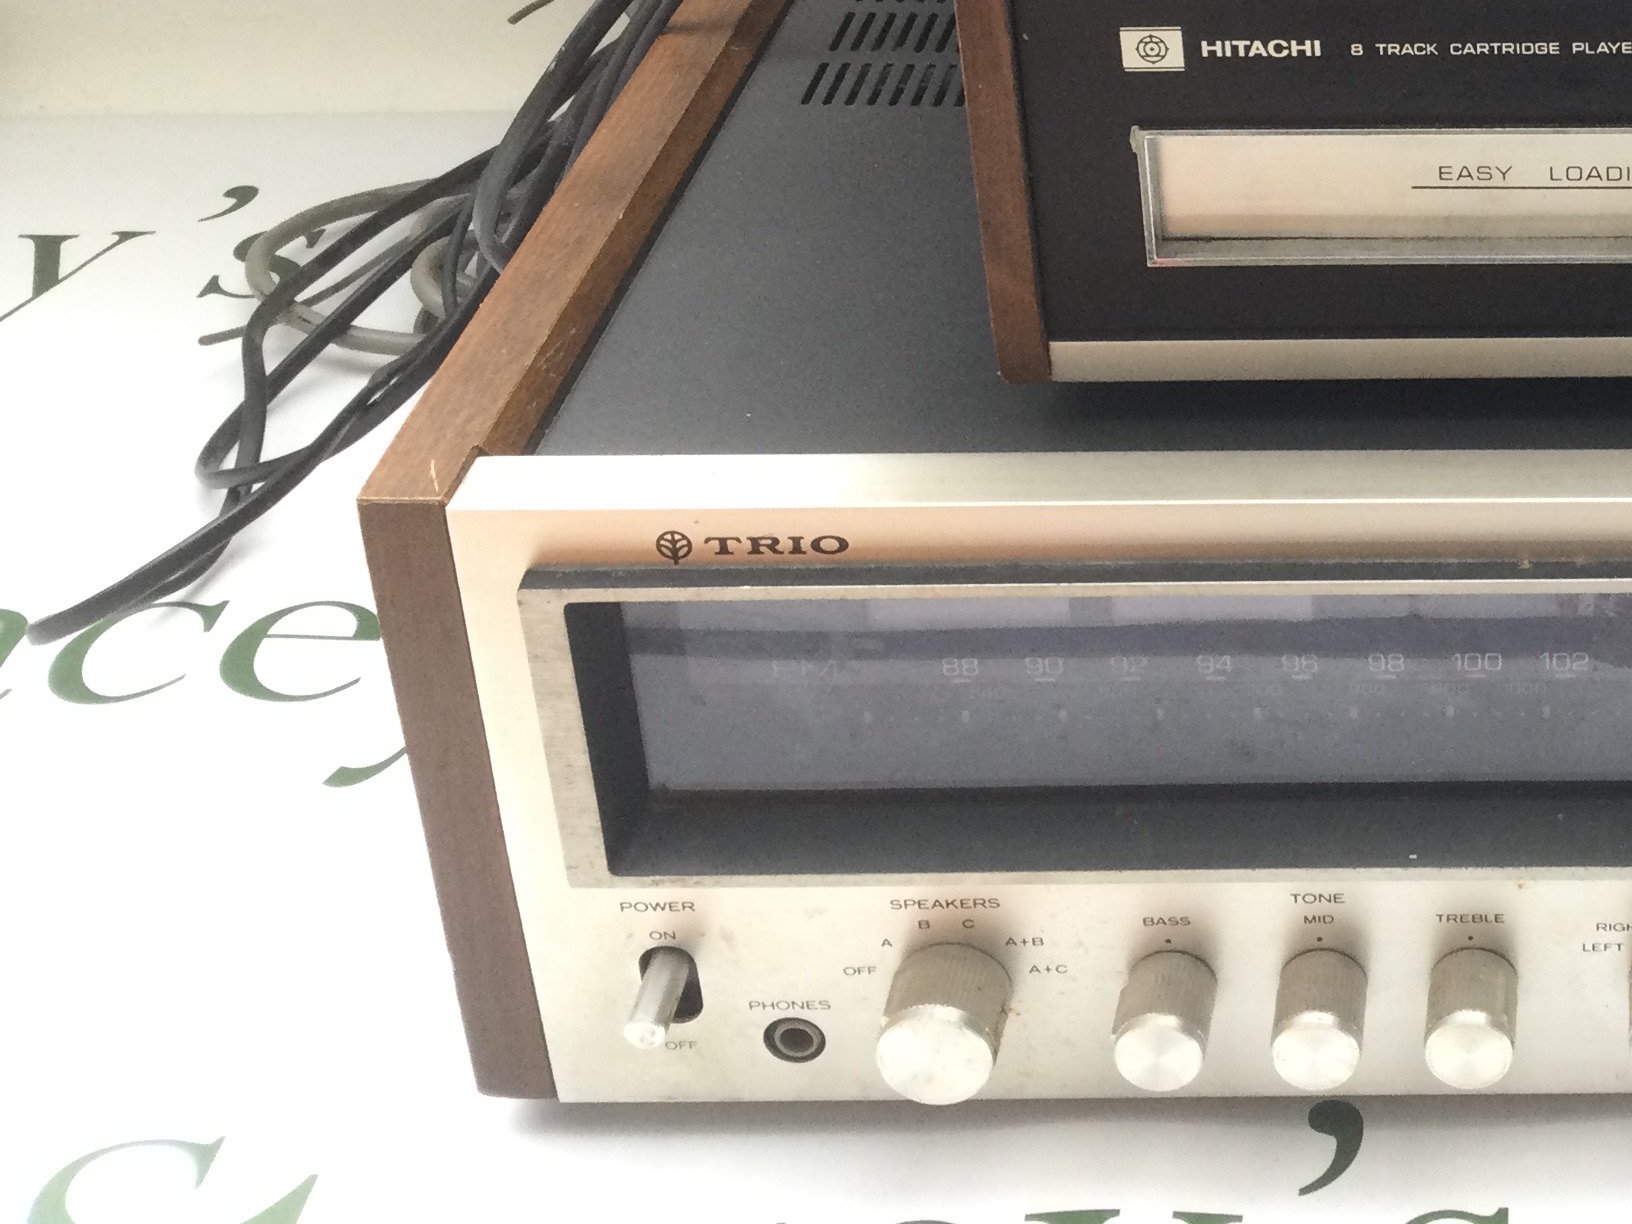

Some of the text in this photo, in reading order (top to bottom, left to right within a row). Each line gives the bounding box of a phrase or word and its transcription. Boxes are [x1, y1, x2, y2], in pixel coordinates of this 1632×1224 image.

[1201, 40, 1321, 57] HITACHI
[1351, 44, 1363, 55] 8
[1375, 43, 1438, 55] TRACK
[1450, 43, 1559, 55] CARTRIDGE
[1439, 166, 1512, 181] EASY
[704, 535, 849, 555] TRIO
[942, 658, 979, 676] 88
[1025, 656, 1064, 675] 90
[1197, 656, 1232, 673] 94
[1368, 653, 1405, 672] 98
[1451, 653, 1502, 672] 100
[1539, 652, 1589, 671] 102
[890, 898, 1000, 910] SPEAKERS
[1291, 894, 1344, 904] TONE
[620, 902, 695, 912] POWER
[1143, 917, 1190, 926] BASS
[1304, 915, 1334, 924] MID
[1436, 914, 1504, 923] TREBLE
[918, 919, 974, 929] B C
[649, 931, 676, 939] ON
[882, 937, 1044, 947] A A+B
[1583, 943, 1621, 952] LEFT
[843, 965, 1067, 975] OFF A+C
[749, 1000, 831, 1010] PHONES
[664, 1040, 699, 1050] OFF
